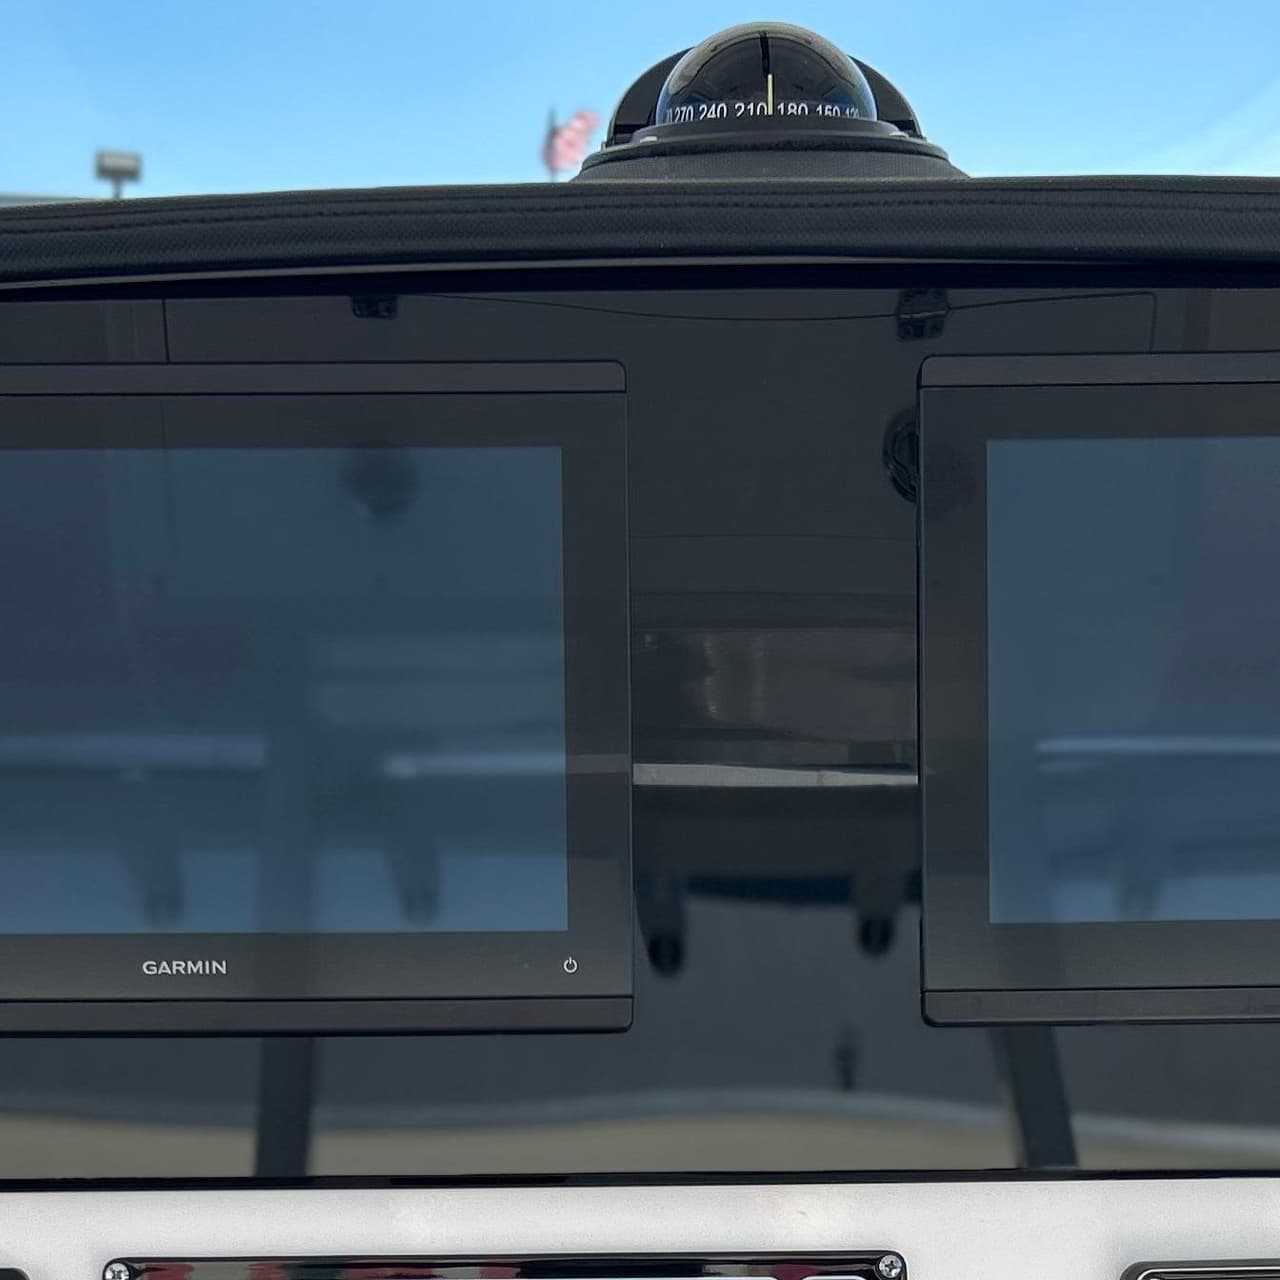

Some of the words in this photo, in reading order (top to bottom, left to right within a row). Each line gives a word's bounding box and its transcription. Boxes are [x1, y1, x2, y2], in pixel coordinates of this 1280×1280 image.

[698, 103, 728, 120] 240
[734, 102, 767, 117] 210
[142, 960, 228, 975] GARMIN
